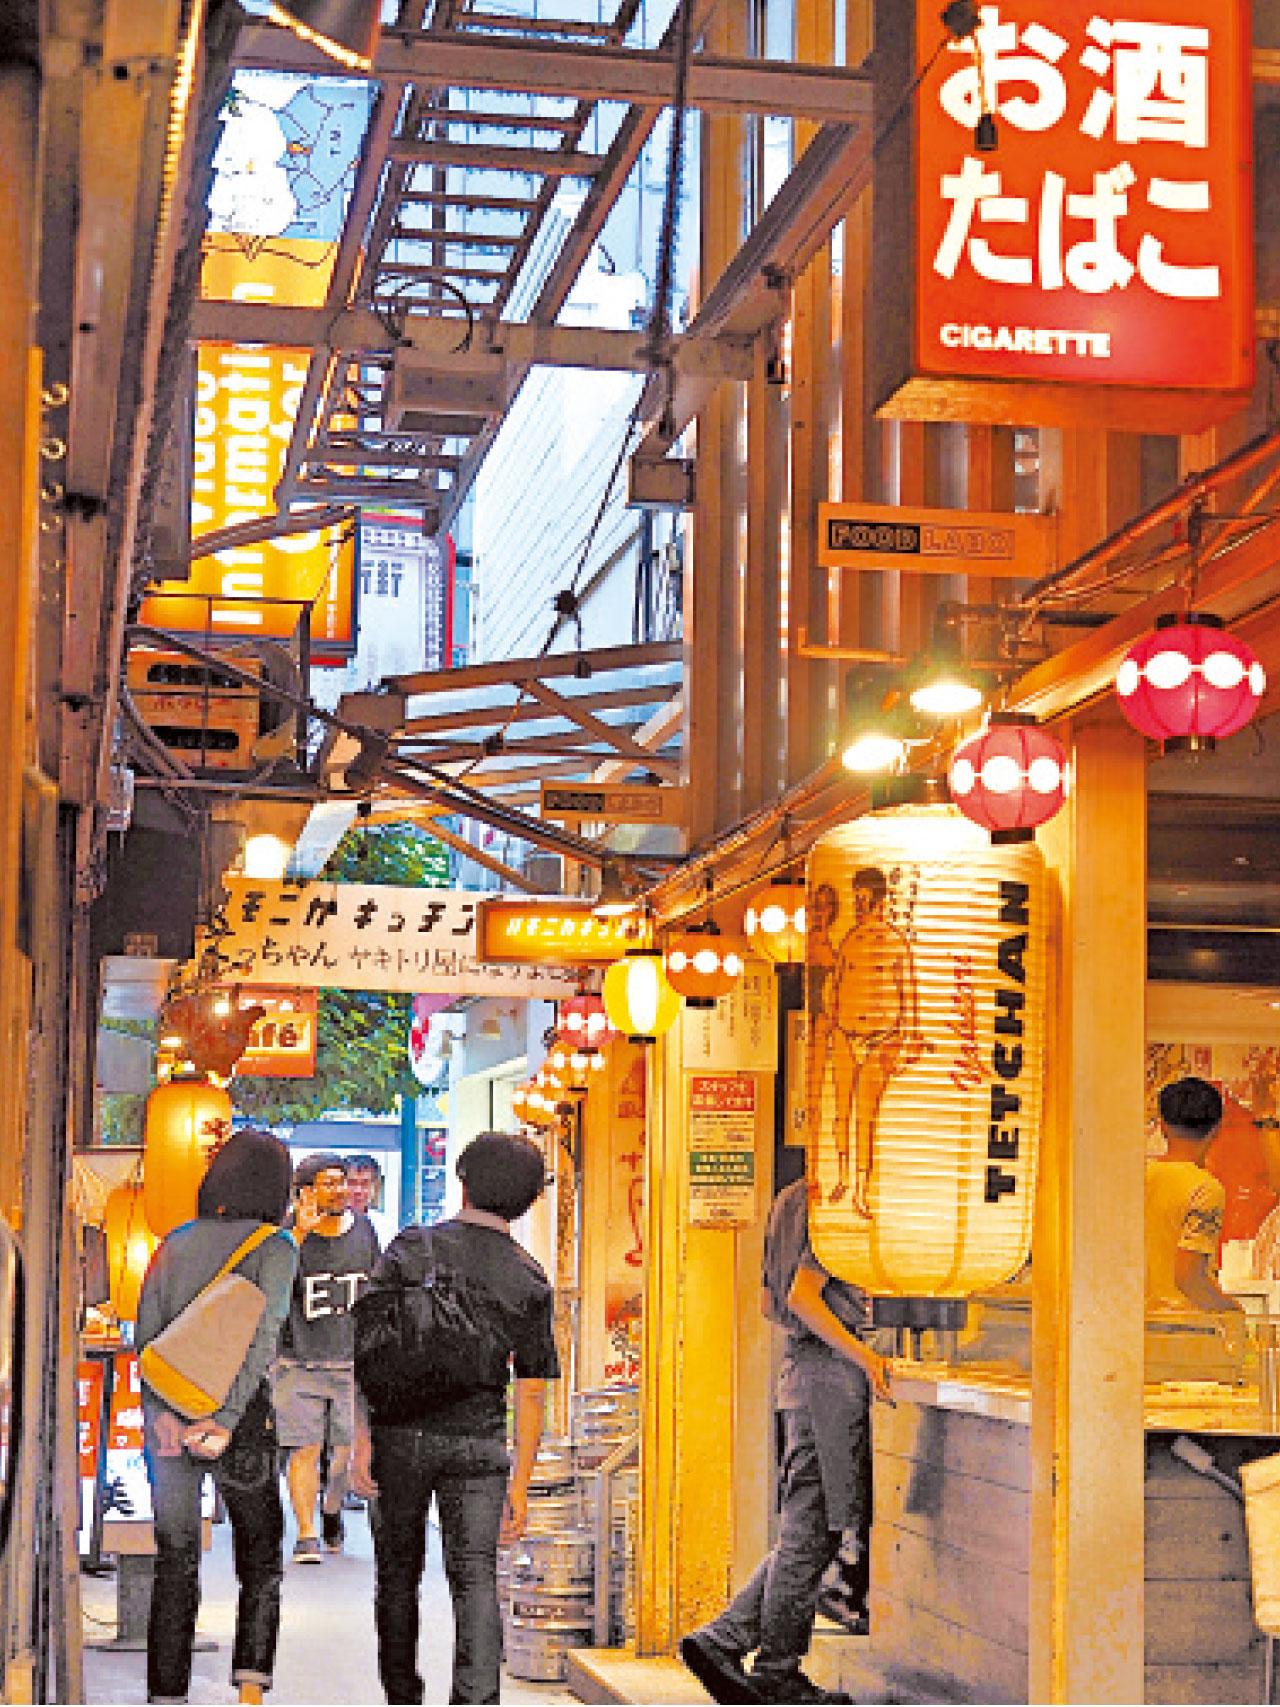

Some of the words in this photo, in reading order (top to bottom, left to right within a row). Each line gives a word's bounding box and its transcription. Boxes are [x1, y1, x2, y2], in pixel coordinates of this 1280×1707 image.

[940, 6, 1209, 148] お酒
[933, 155, 1221, 298] たばこ
[940, 323, 1111, 358] CIGARETTE
[211, 282, 274, 625] Infrmatin
[831, 523, 918, 551] FOOD
[240, 890, 475, 936] モニカキッチン
[984, 880, 1030, 1204] TETCHAN
